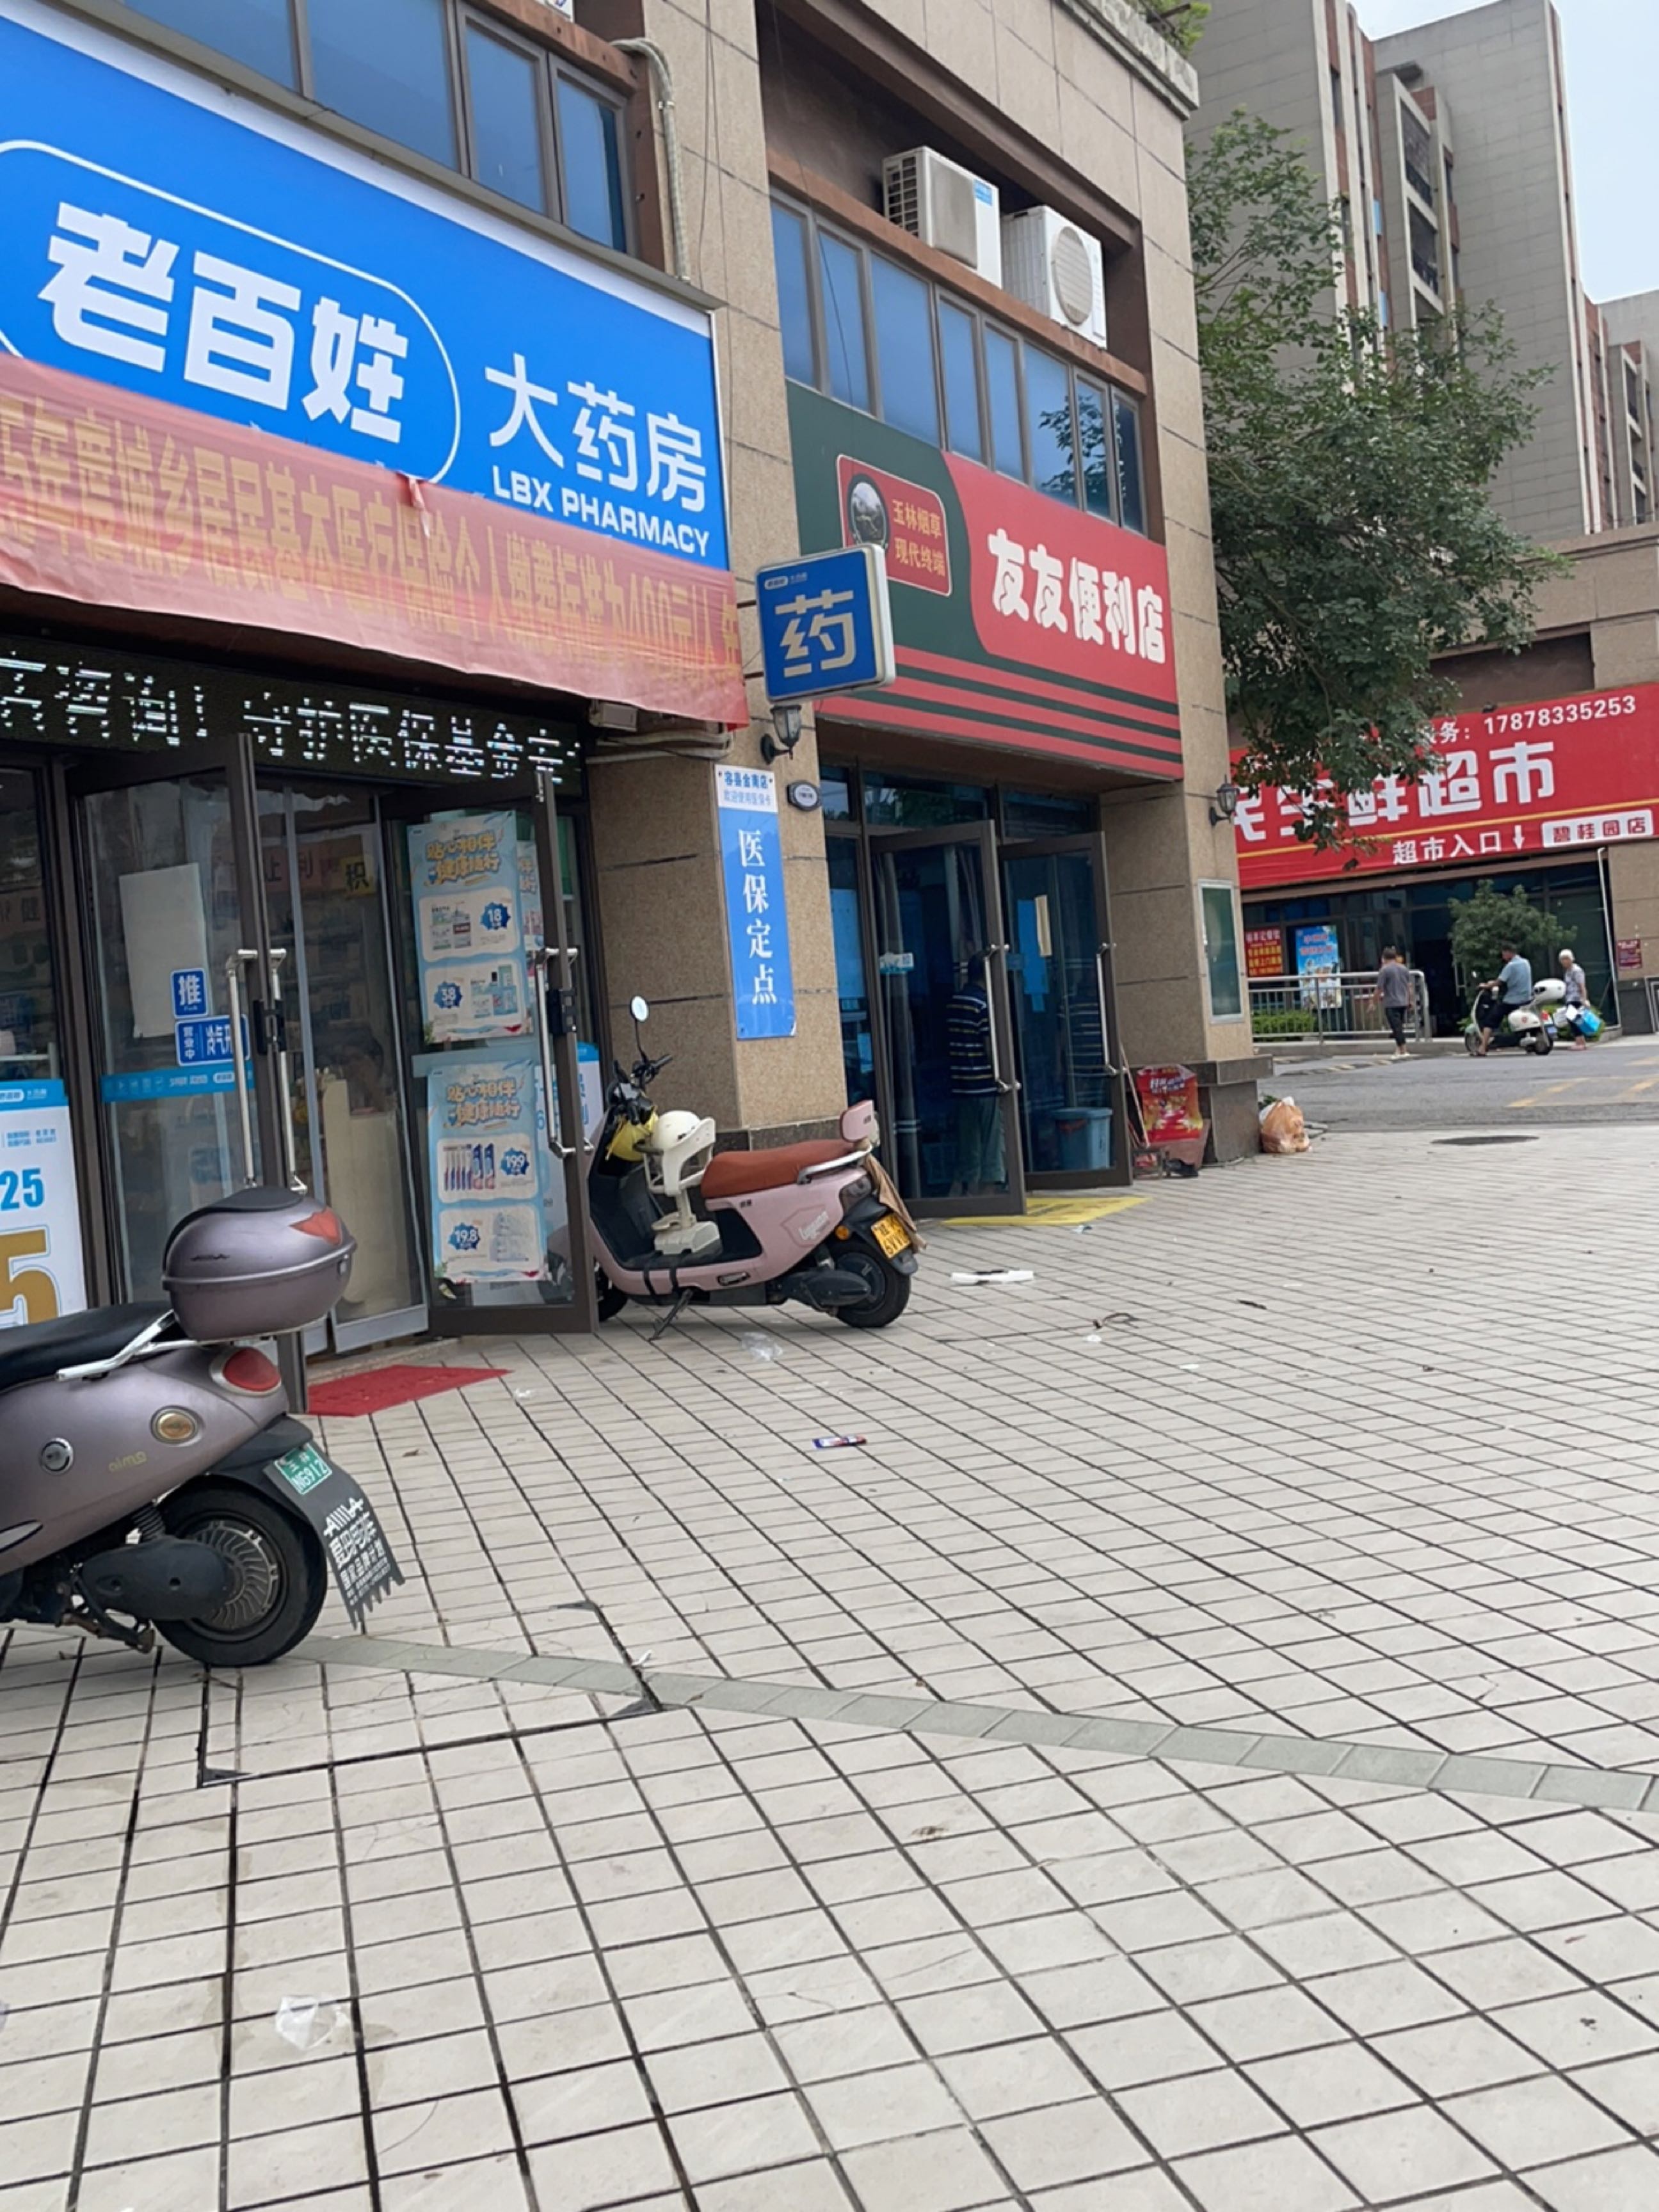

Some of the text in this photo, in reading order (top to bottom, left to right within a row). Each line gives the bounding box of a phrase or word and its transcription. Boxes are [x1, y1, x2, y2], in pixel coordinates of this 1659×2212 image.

[38, 202, 706, 512] 老百姓 大药房
[492, 465, 710, 557] LBX PHARMACY
[892, 499, 942, 539] 玉林烟草
[894, 537, 945, 577] 现代终端
[988, 528, 1166, 664] 友友便利店
[775, 589, 856, 678] 药
[1484, 695, 1636, 735] 17878335253
[1392, 830, 1502, 865] 超市入口
[737, 828, 777, 1005] 医保定点
[178, 975, 202, 1006] 推
